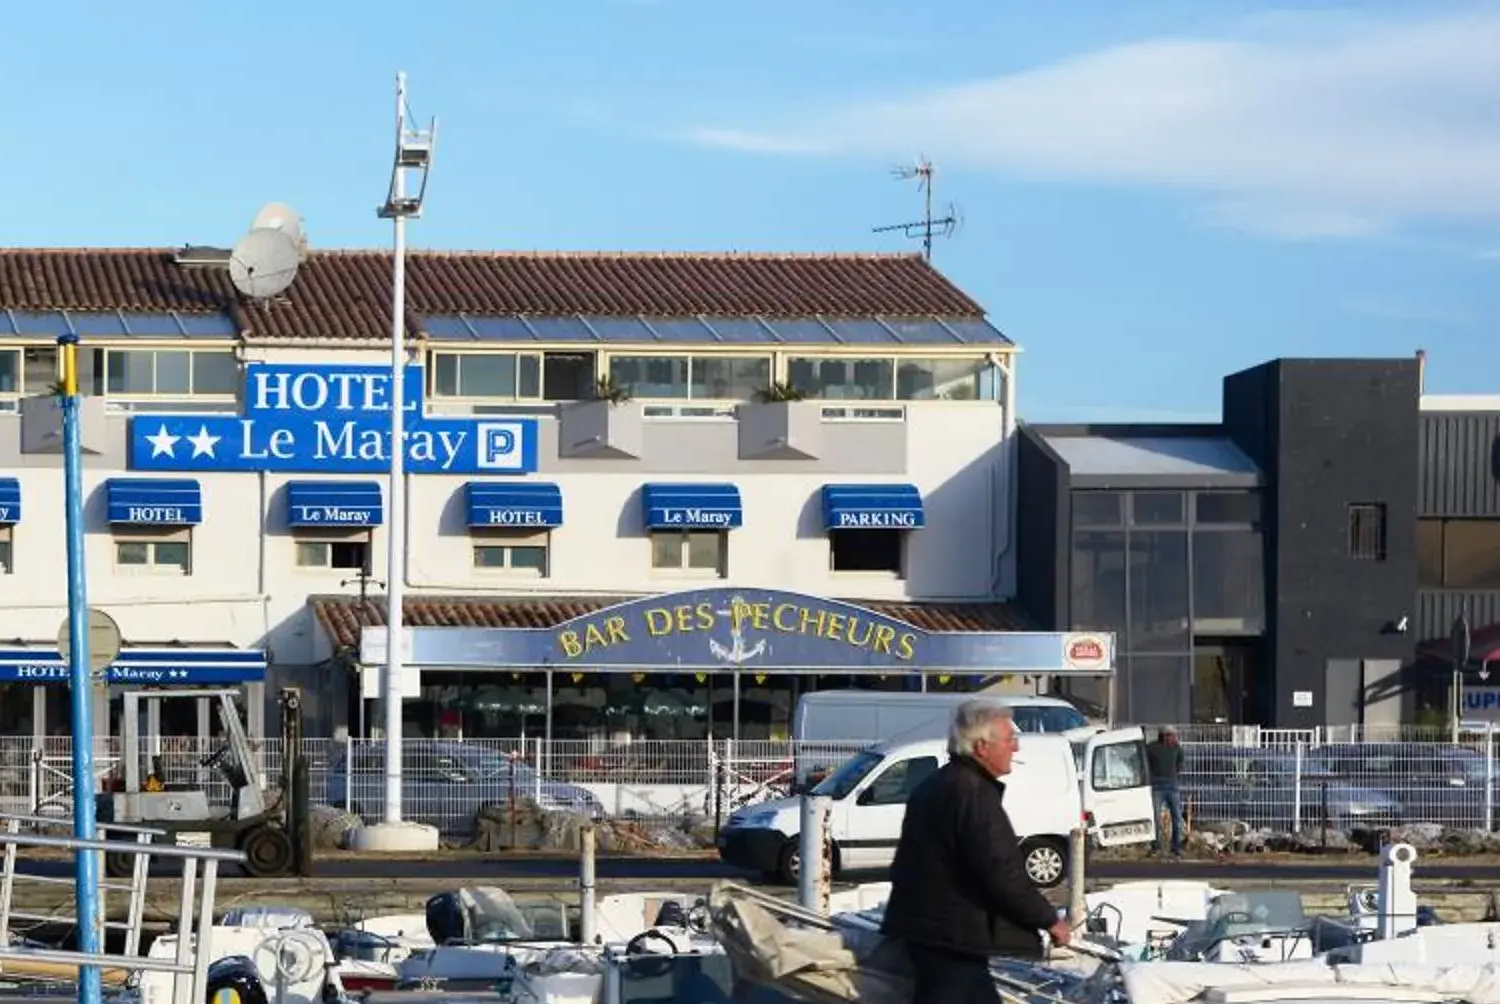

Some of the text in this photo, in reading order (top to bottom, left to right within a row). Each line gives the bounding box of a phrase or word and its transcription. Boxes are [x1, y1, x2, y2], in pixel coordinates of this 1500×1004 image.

[253, 373, 417, 411] HOTEL
[239, 419, 295, 459] Le
[129, 508, 183, 522] HOTEL
[302, 507, 371, 524] Le Maray
[490, 510, 547, 524] HOTEL
[664, 509, 732, 526] Le Maray
[840, 512, 916, 526] PARKING
[560, 602, 917, 661] BAR DES PECHEURS
[17, 665, 71, 678] HOTE
[112, 667, 164, 681] Maray
[1462, 692, 1500, 709] UP
